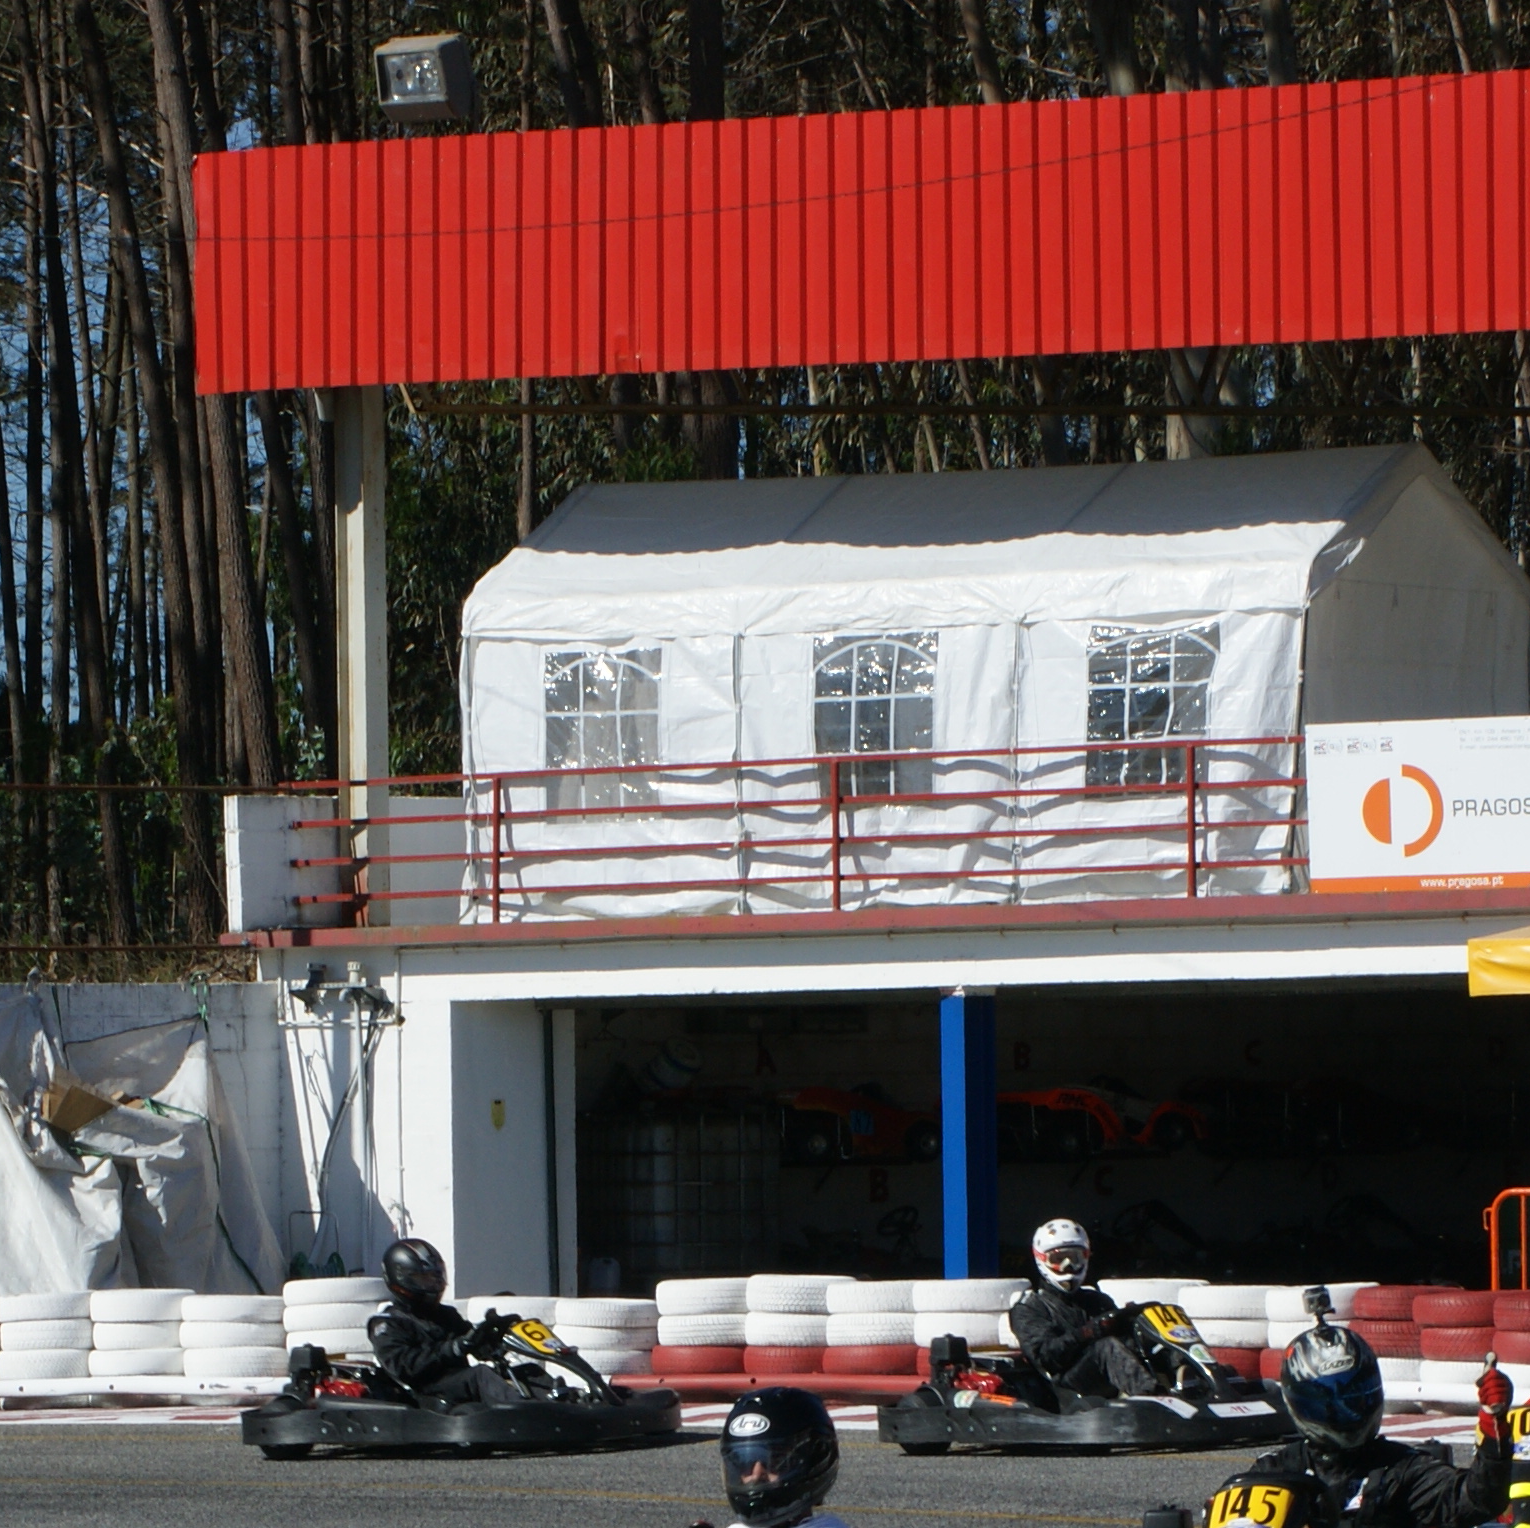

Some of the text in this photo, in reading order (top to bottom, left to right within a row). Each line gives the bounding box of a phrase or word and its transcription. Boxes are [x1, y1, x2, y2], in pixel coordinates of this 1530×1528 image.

[1420, 873, 1504, 890] www.pragosa.pt
[1013, 1041, 1031, 1071] B
[870, 1168, 890, 1203] B
[1218, 1487, 1283, 1525] 145
